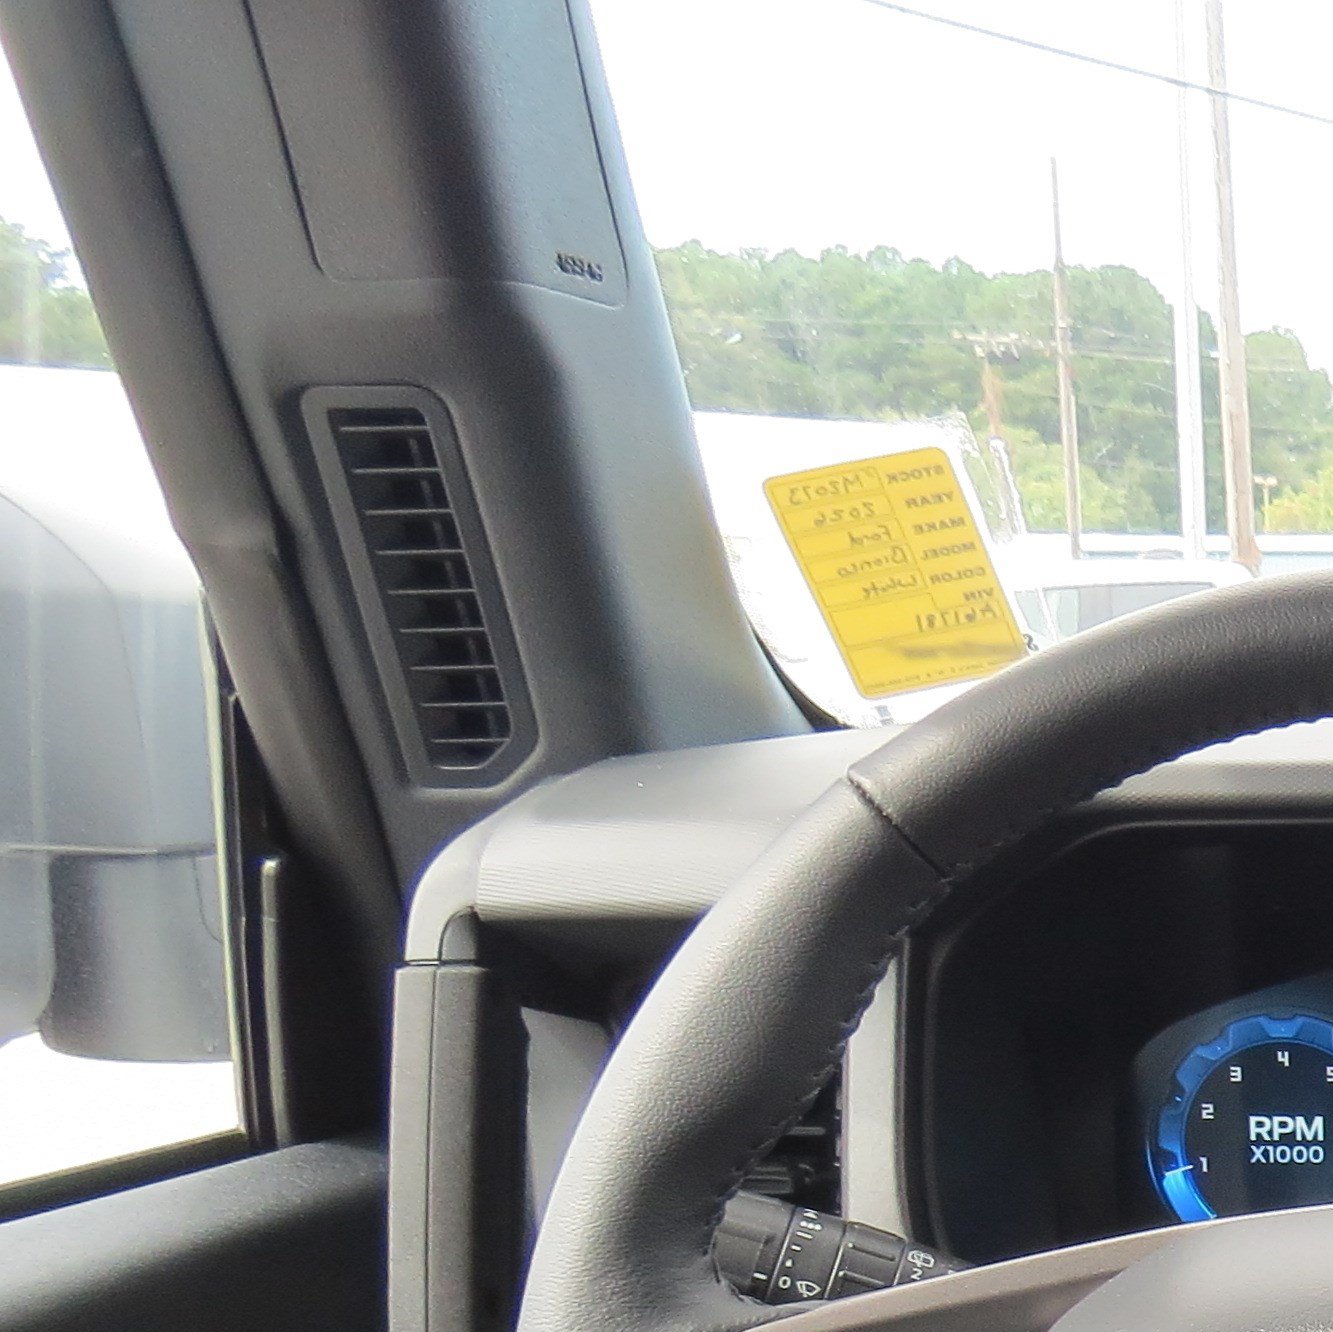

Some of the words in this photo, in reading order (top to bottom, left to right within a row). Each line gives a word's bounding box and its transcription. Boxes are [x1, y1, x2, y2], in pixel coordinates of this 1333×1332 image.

[1277, 1051, 1290, 1067] 4
[1230, 1067, 1242, 1082] 3
[1201, 1104, 1214, 1119] 2
[1249, 1116, 1324, 1141] RPM
[1250, 1145, 1324, 1163] X1000
[1200, 1157, 1209, 1172] 1
